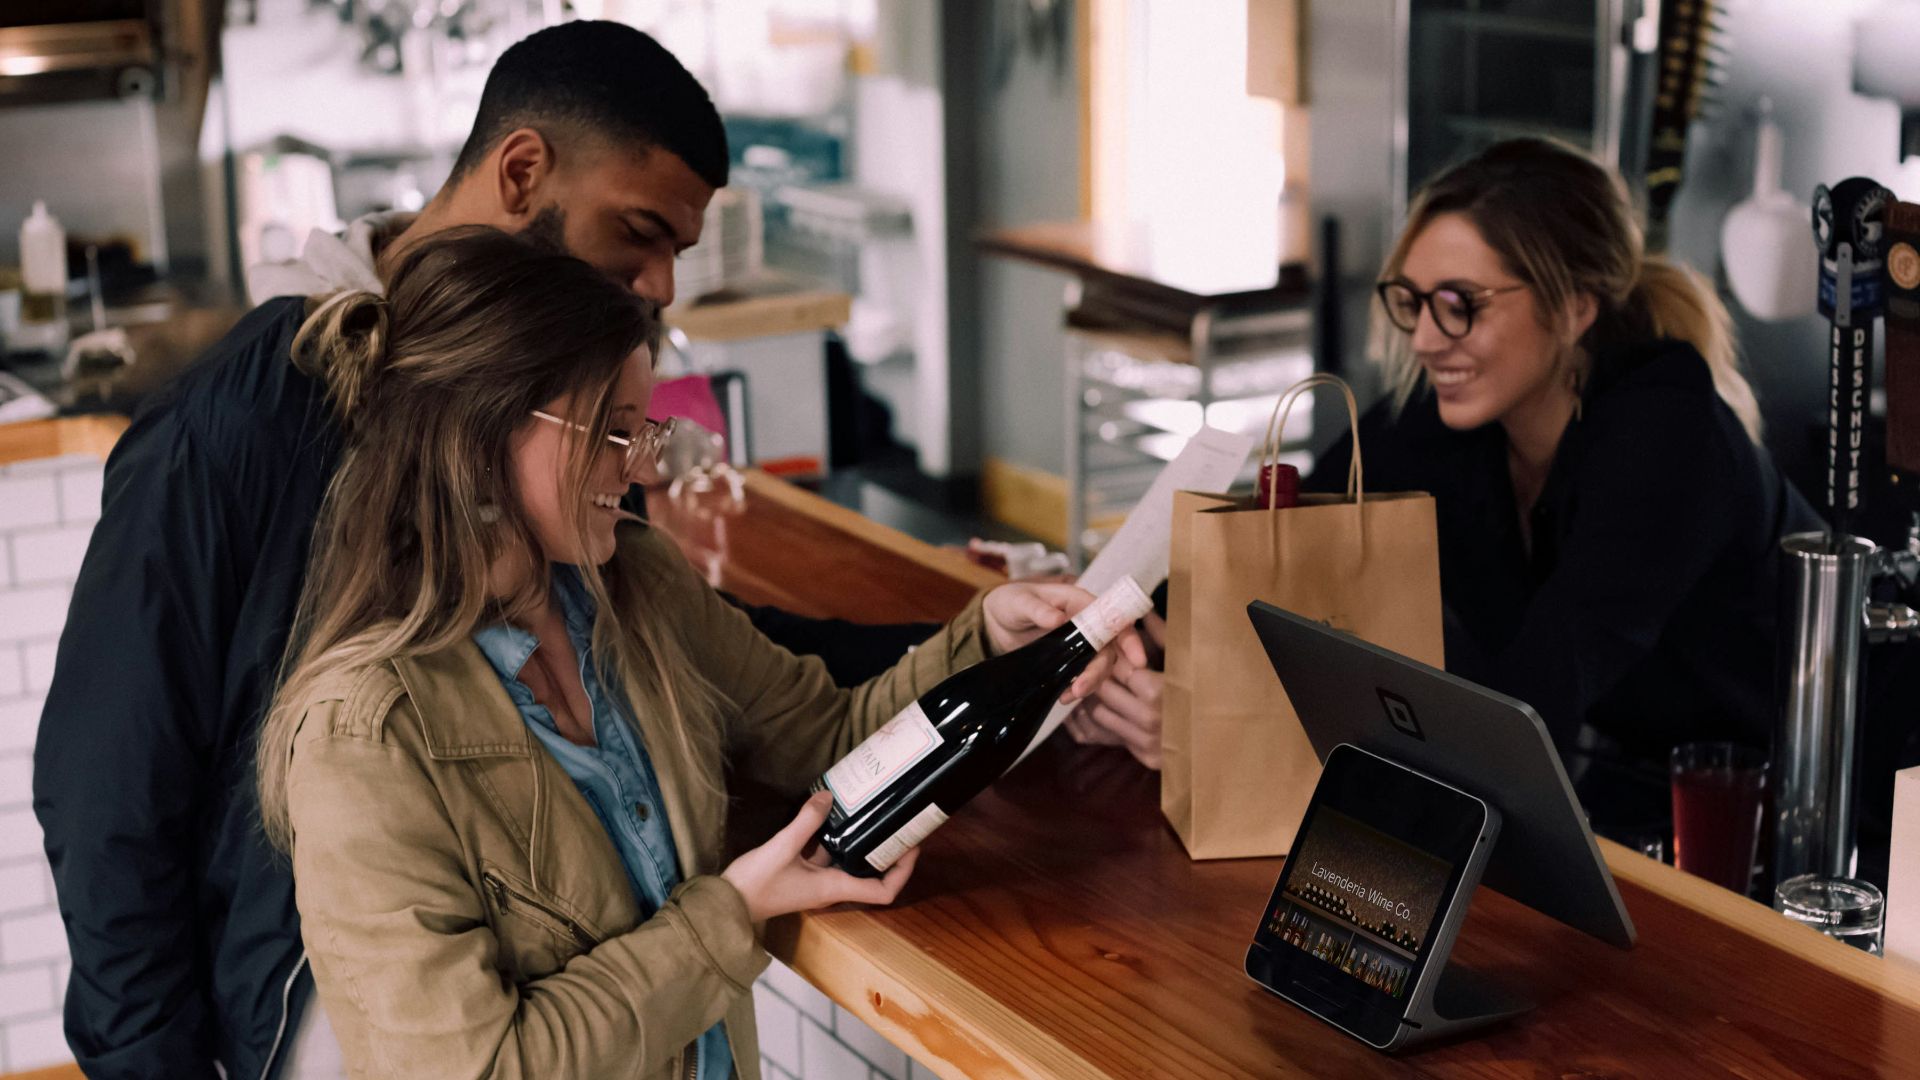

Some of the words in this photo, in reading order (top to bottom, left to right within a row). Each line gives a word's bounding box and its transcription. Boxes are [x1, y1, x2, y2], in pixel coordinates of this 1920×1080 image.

[1848, 328, 1865, 509] DESCHUTES
[1311, 861, 1367, 898] Lavenderia
[1367, 887, 1395, 912] Wine
[1395, 902, 1412, 922] Co.
